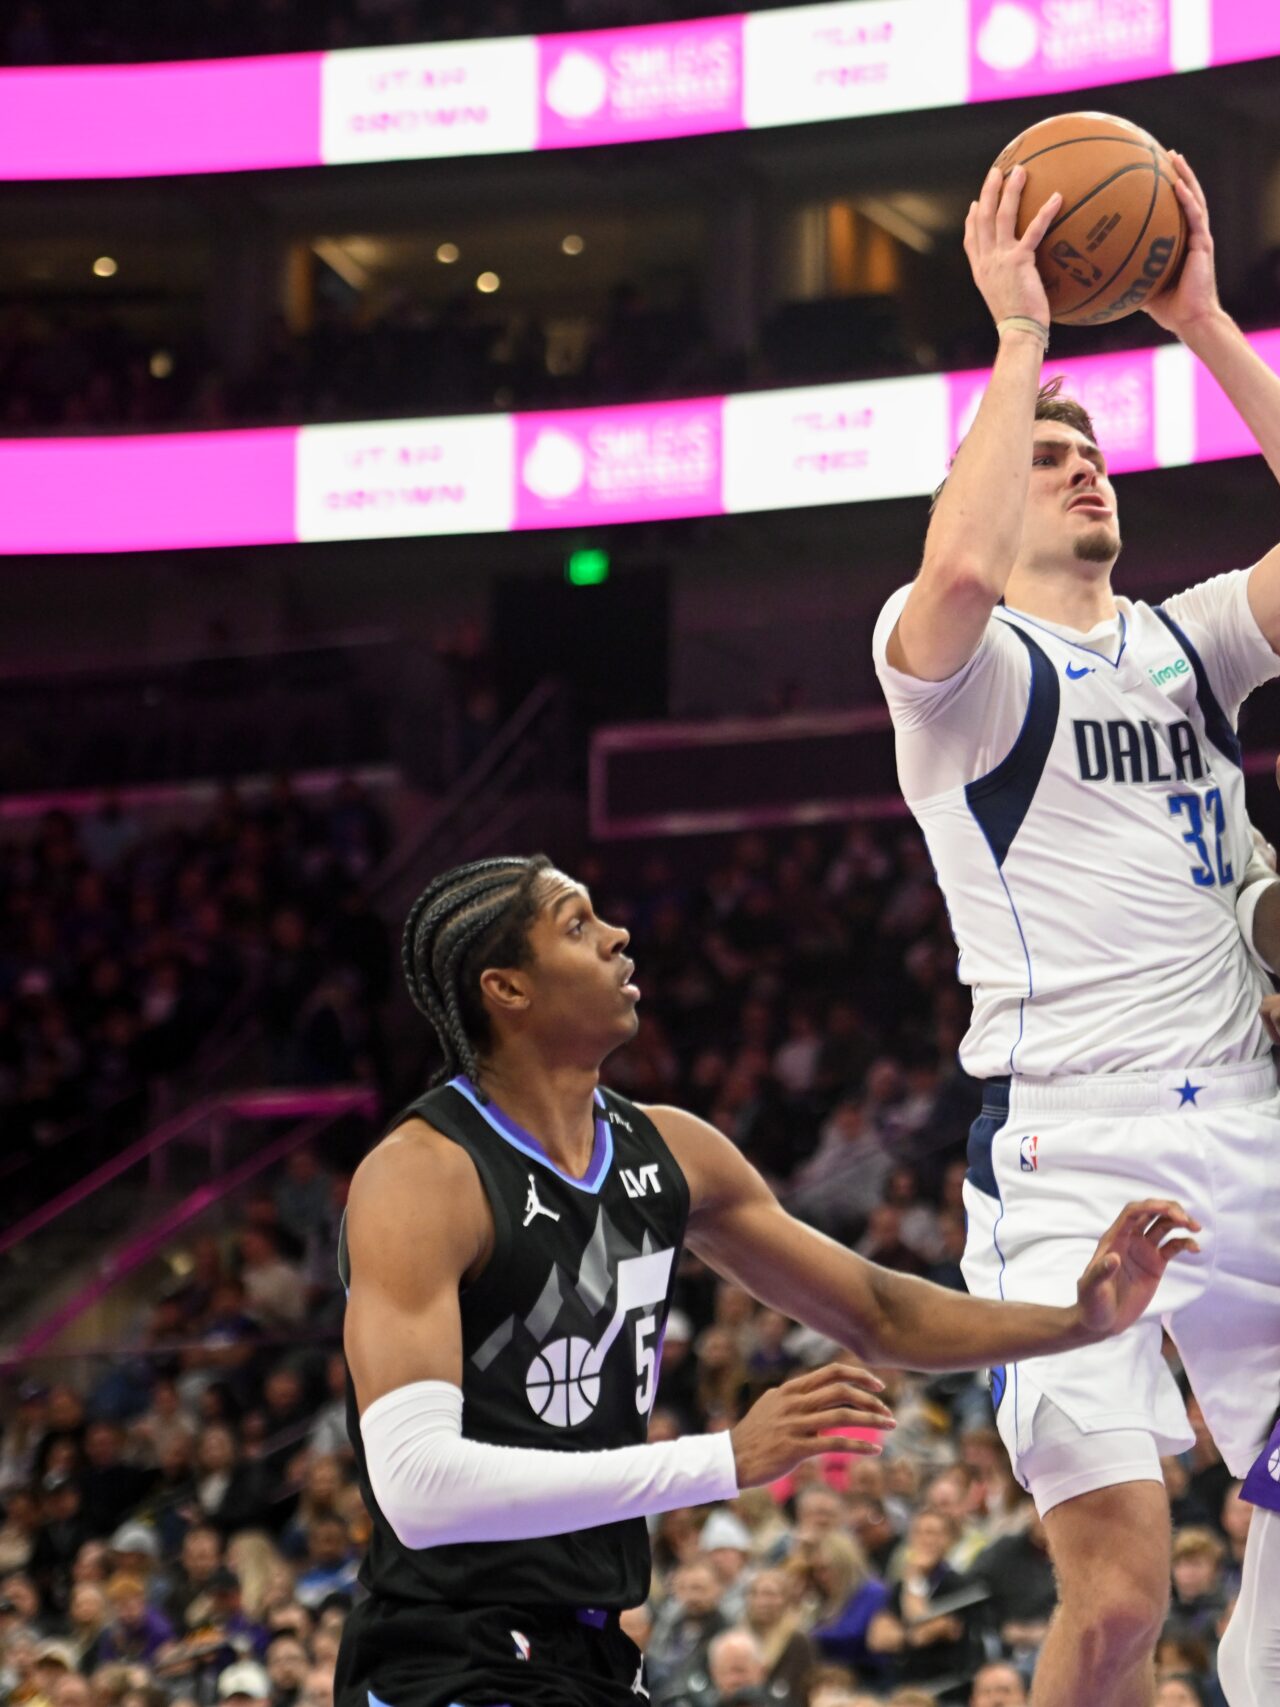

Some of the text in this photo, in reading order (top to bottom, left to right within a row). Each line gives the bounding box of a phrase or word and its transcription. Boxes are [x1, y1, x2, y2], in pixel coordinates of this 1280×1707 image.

[1168, 787, 1235, 887] 32
[619, 1164, 662, 1198] LVT
[635, 1315, 656, 1415] 5
